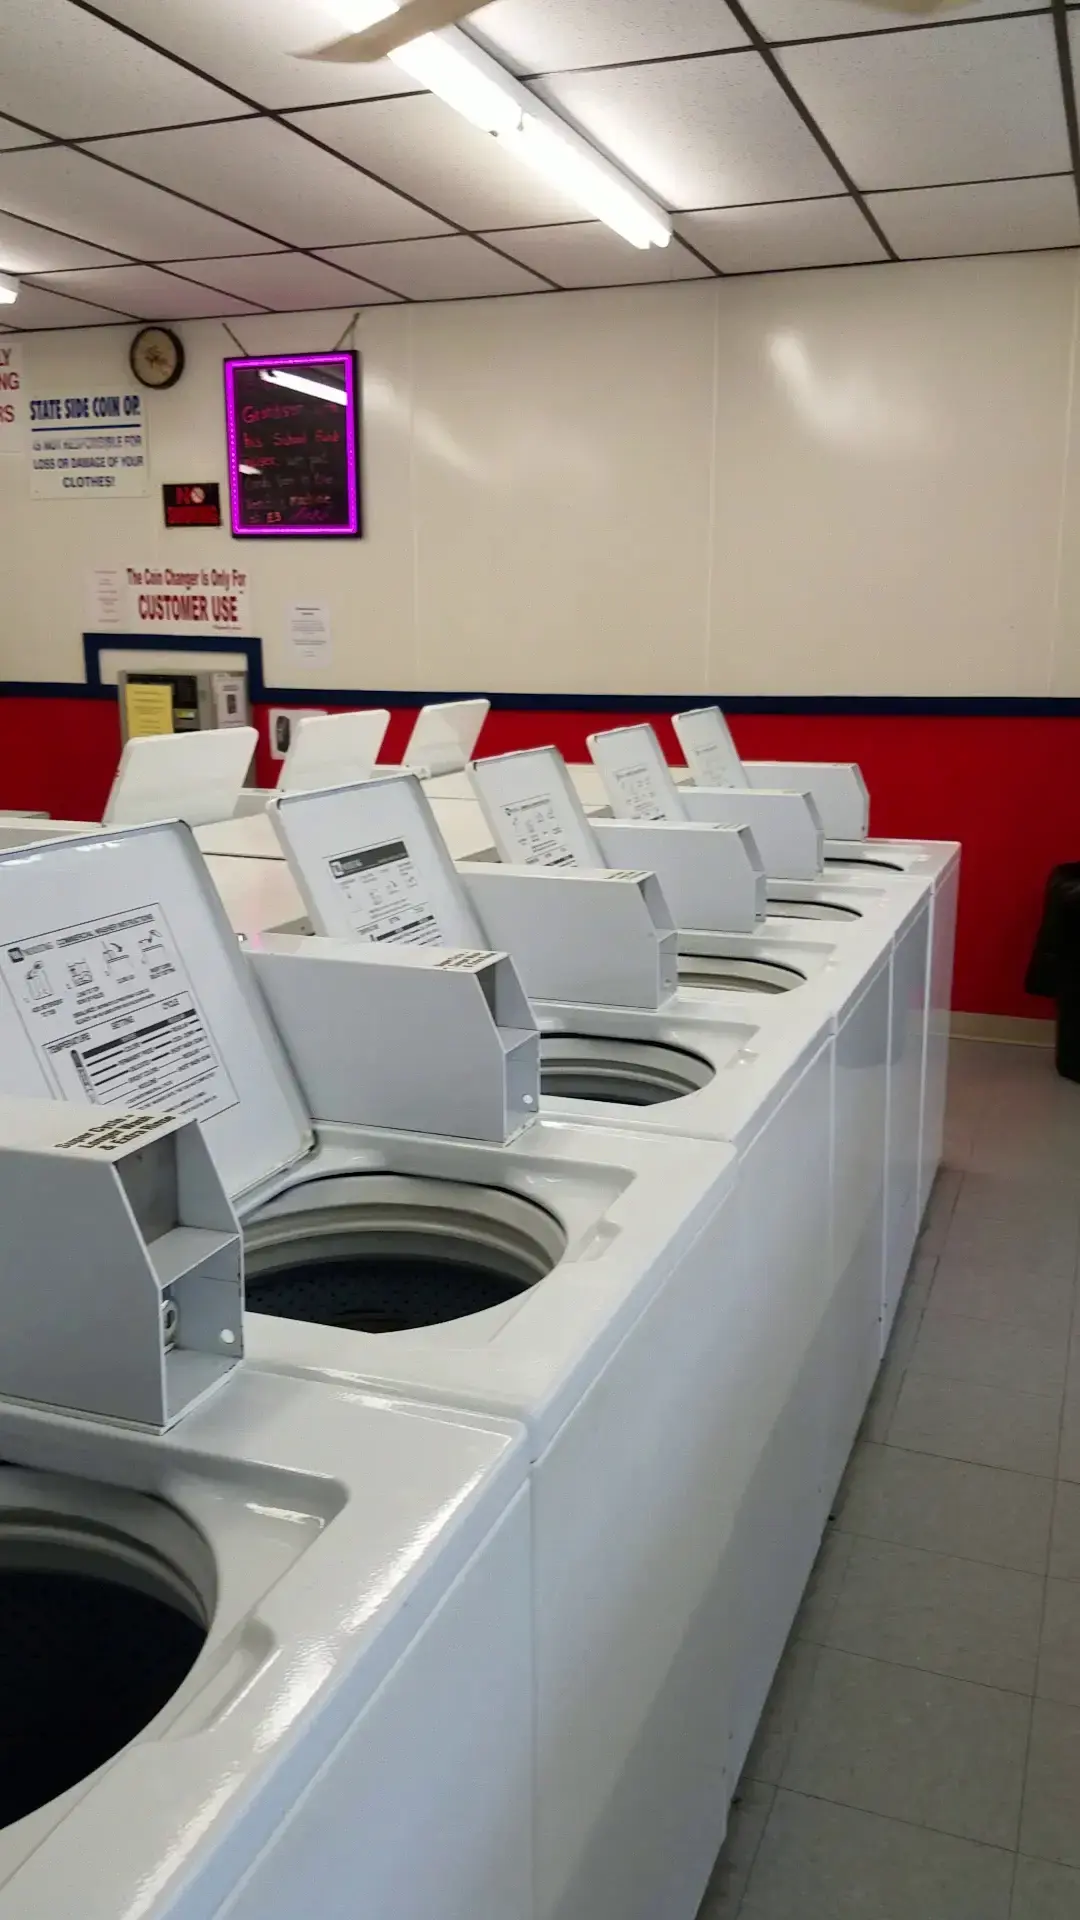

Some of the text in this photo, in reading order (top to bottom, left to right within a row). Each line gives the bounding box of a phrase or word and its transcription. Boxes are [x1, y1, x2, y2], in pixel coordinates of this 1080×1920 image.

[30, 399, 61, 420] STATE
[65, 397, 89, 419] SIDE
[93, 396, 119, 417] COIN
[33, 455, 144, 470] LOSS OR DAMAGE OF YOUR
[127, 568, 142, 585] The
[144, 568, 163, 586] Coin
[165, 568, 199, 590] Changer
[211, 568, 230, 591] Only
[232, 568, 247, 587] For
[138, 595, 209, 621] CUSTOMER
[211, 595, 239, 622] USE
